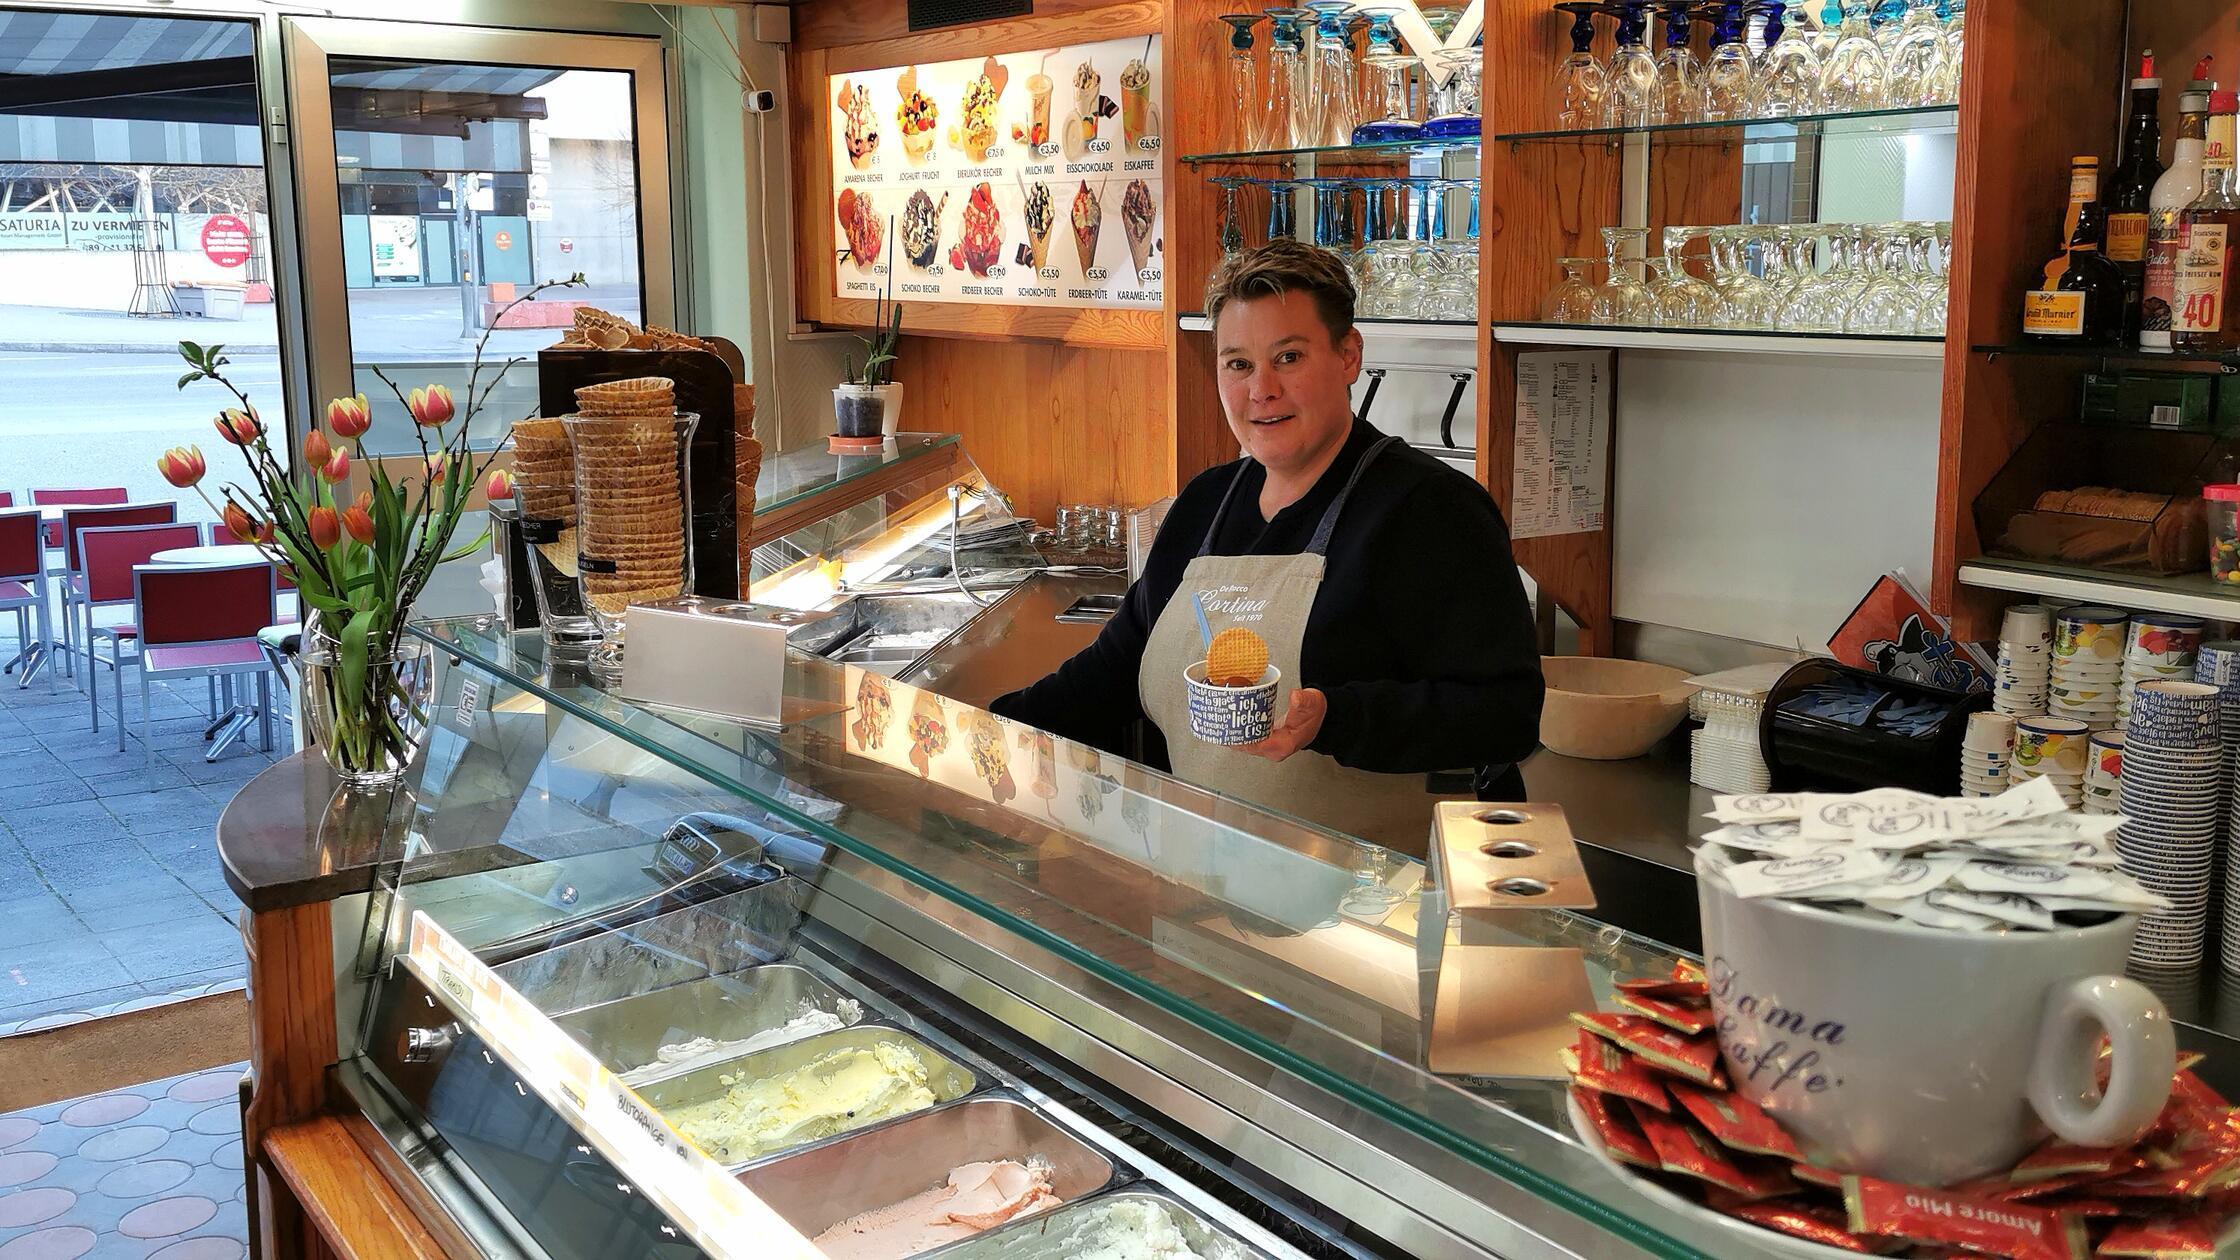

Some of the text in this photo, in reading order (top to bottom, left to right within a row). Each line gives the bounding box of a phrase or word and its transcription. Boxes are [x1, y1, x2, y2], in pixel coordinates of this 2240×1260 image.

[1140, 138, 1161, 149] €6,50
[1025, 164, 1055, 175] MILCH MIX
[1066, 162, 1114, 173] EISSCHOKOLADE
[1124, 160, 1154, 171] EISKAFFEE
[983, 168, 1002, 177] BECHER
[71, 220, 169, 231] ZU VERMIEEN
[1041, 270, 1060, 279] €5,50
[1088, 270, 1107, 279] €5,50
[1140, 270, 1162, 280] €5,50
[846, 282, 868, 290] SPAGHETTI
[902, 284, 940, 293] SCHOKO BECHER
[962, 286, 1003, 296] ERDBEER BECHER
[1018, 287, 1056, 298] SCHOKO-TÜTE
[1068, 288, 1108, 299] ERDBEER-TÜTE
[1117, 290, 1162, 301] KARAMEL-TÜTE
[2183, 292, 2216, 328] 40
[1198, 590, 1270, 614] Cortina
[1246, 614, 1263, 622] 1970
[1239, 696, 1258, 711] ich
[1232, 710, 1262, 728] liebe
[1245, 723, 1262, 738] Eis
[2194, 724, 2215, 738] love
[1905, 1194, 2043, 1236] Amore Mio
